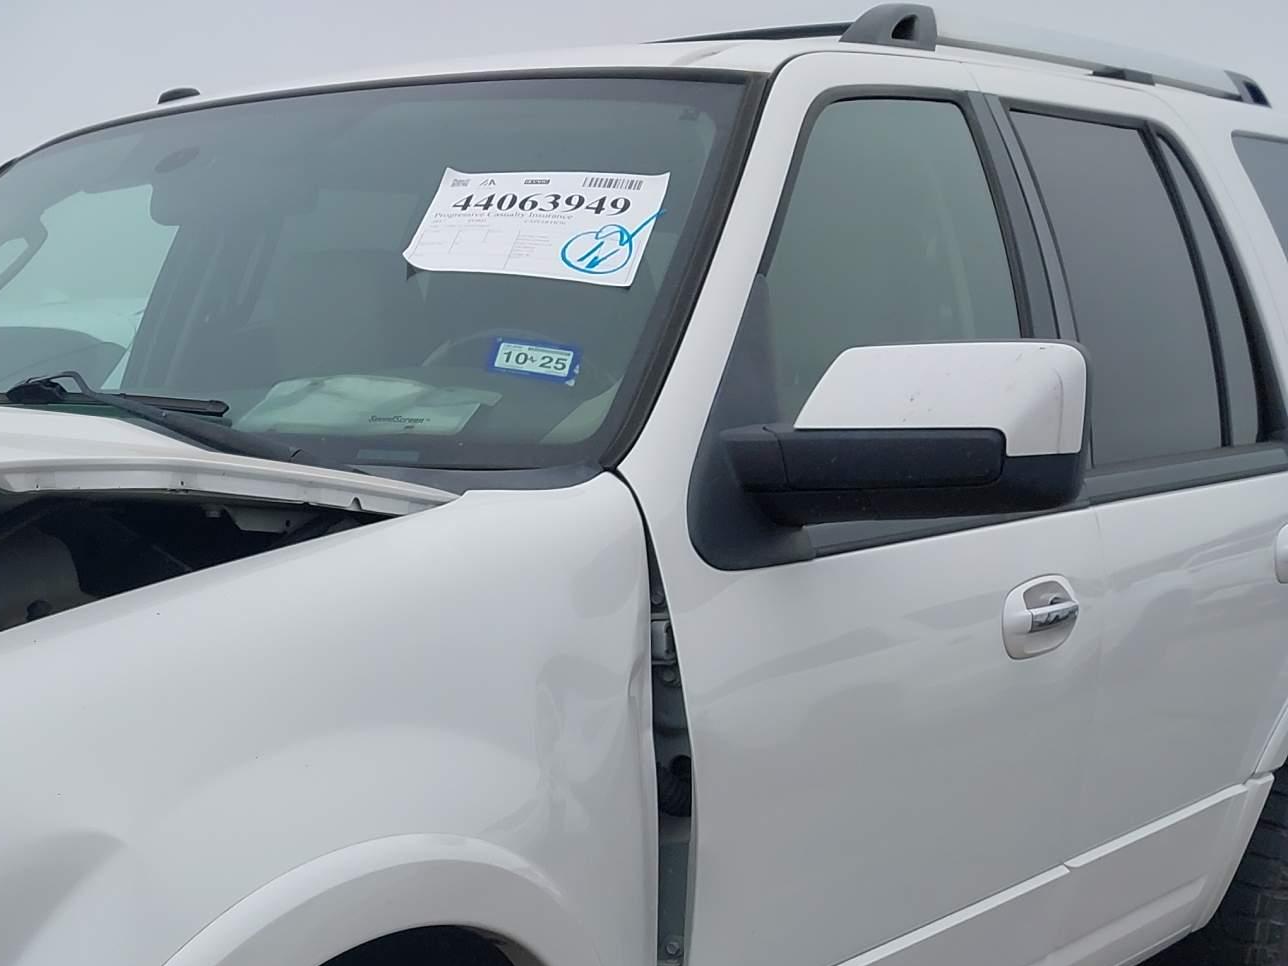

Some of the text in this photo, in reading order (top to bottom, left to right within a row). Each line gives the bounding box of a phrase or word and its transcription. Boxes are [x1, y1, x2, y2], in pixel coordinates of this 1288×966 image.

[452, 193, 631, 216] 44063949
[503, 351, 568, 371] 10 25
